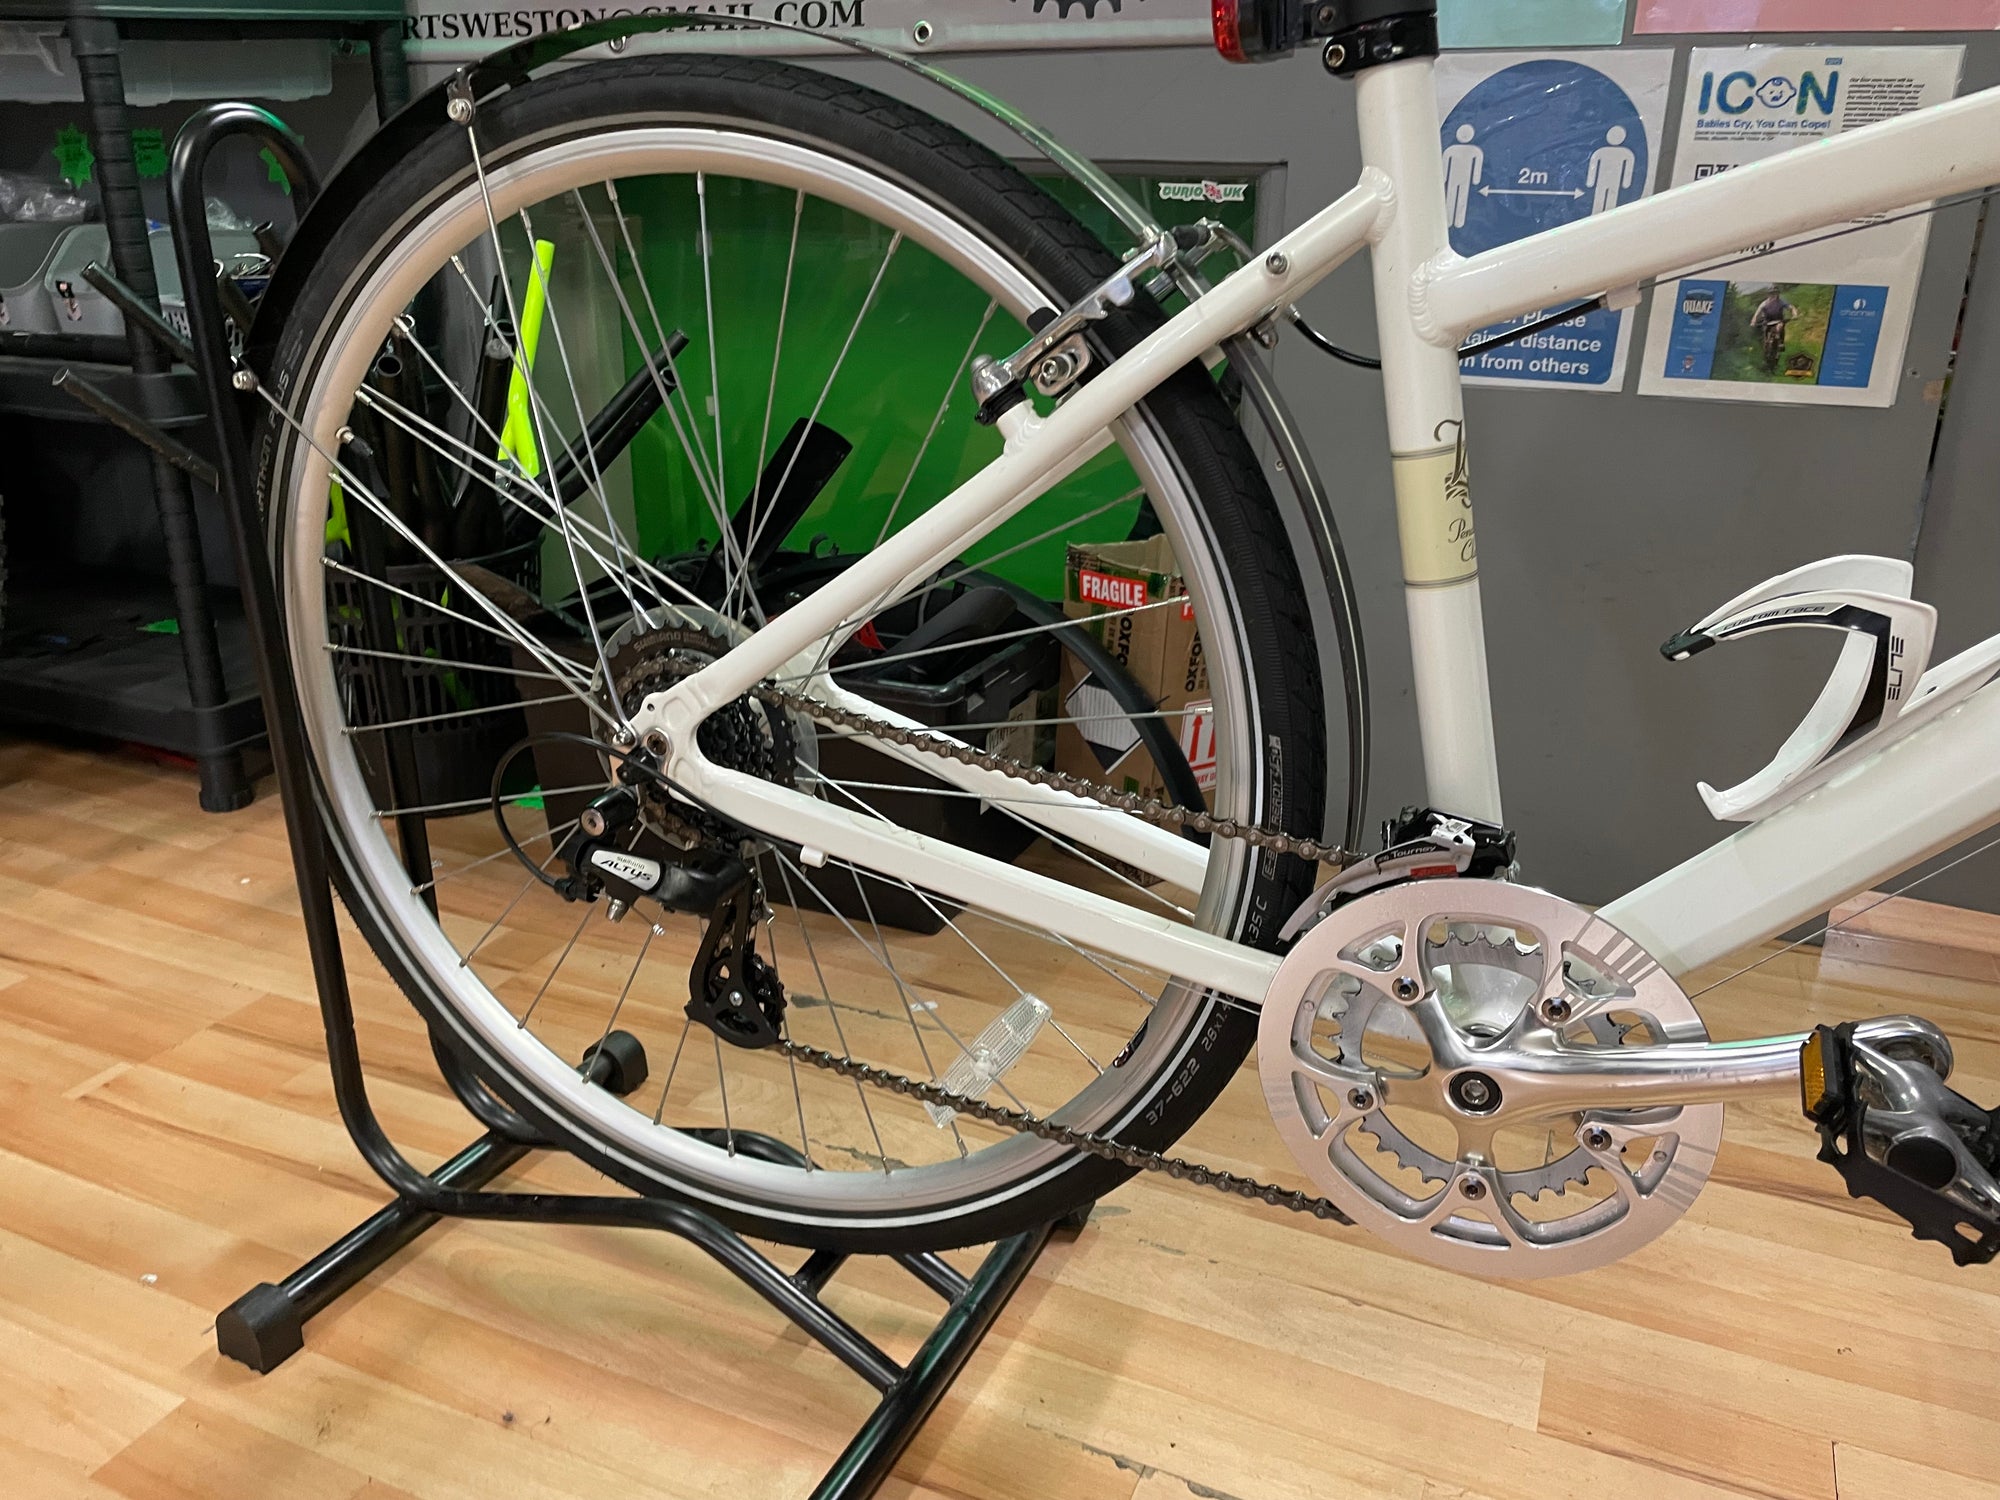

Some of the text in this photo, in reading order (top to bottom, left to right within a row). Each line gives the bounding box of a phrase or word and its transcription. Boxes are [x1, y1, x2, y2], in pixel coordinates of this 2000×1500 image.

[1697, 119, 1832, 130] Babies Cry, You Can Cope!
[1517, 167, 1548, 184] 2m
[1223, 186, 1243, 197] UK
[1683, 300, 1715, 314] QUAKE
[1520, 334, 1601, 352] distance
[1480, 353, 1523, 371] from
[1528, 357, 1590, 375] others
[1083, 574, 1143, 607] FRAGILE
[1723, 606, 1826, 631] custom race
[1391, 845, 1438, 859] Tourney
[600, 860, 652, 880] ALTUS
[1145, 1057, 1200, 1126] 37-622
